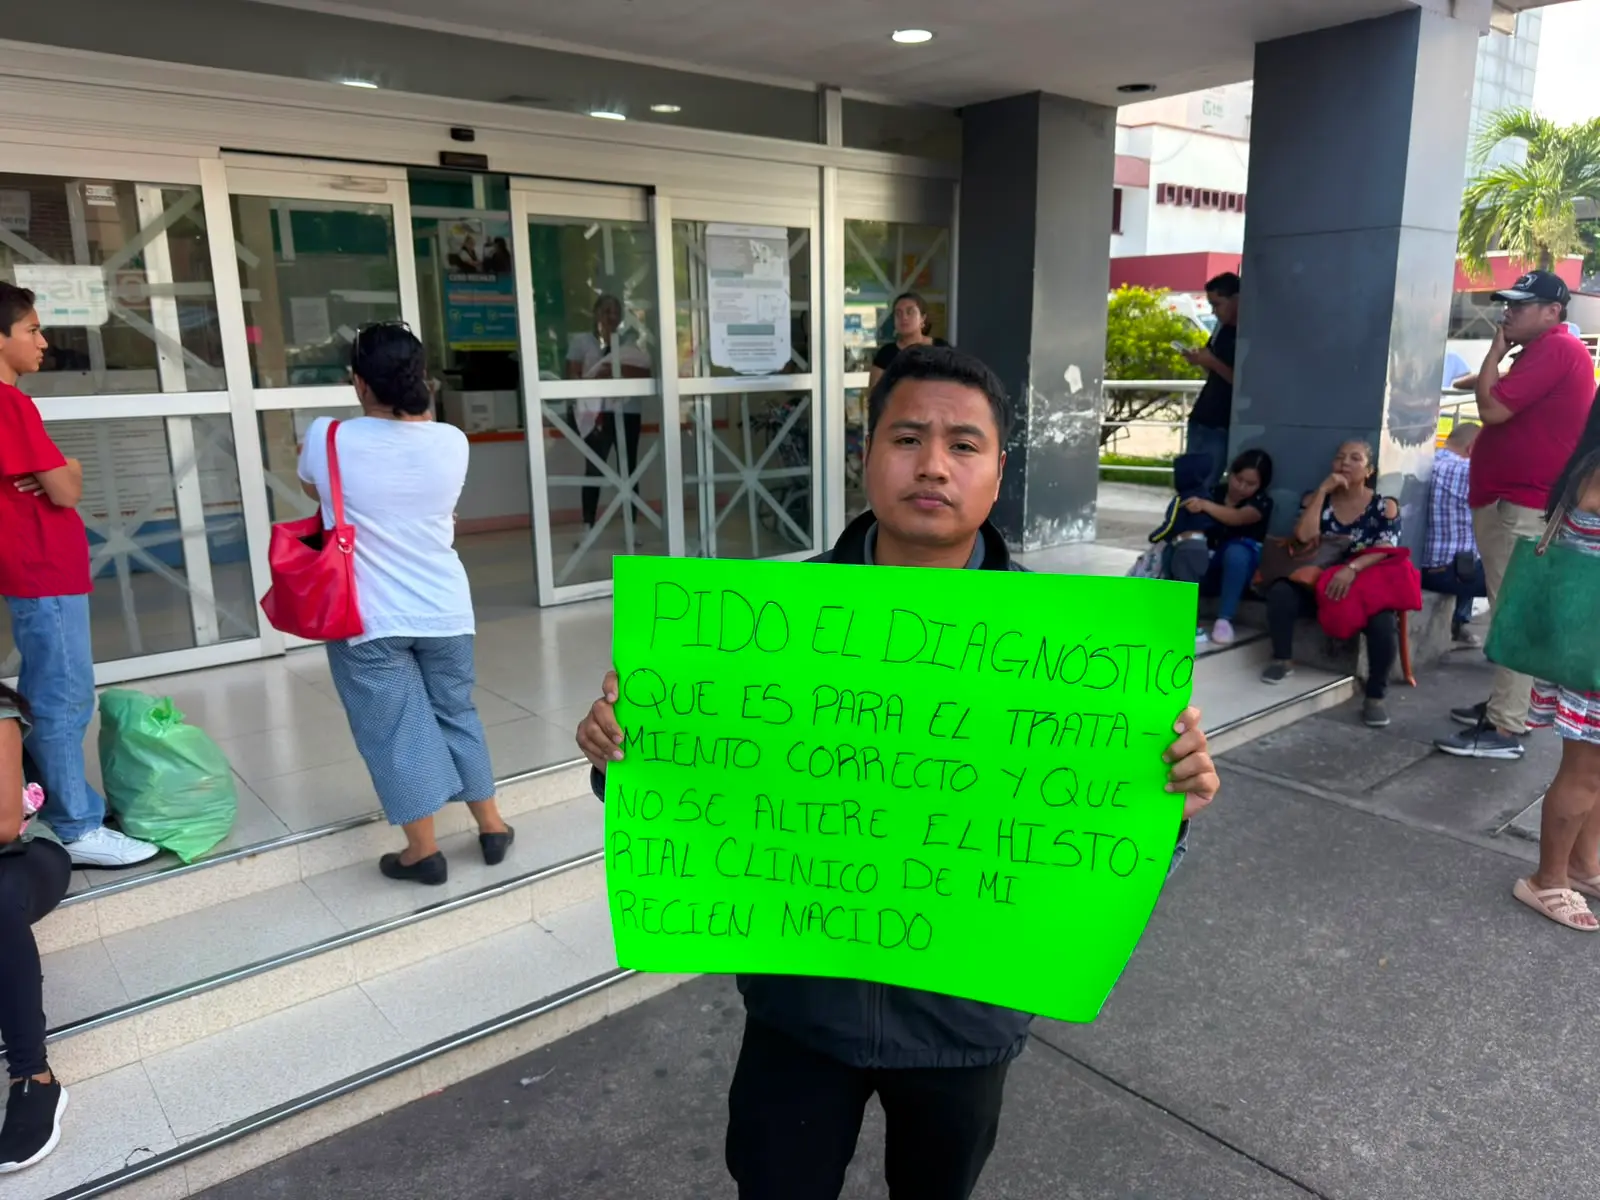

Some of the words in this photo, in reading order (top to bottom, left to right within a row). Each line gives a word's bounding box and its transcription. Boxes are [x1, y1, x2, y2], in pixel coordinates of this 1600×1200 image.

[650, 581, 789, 652] PIDO
[812, 606, 861, 660] EL
[881, 609, 1194, 696] DIAGNÓSTICO
[623, 668, 720, 718] QUE
[742, 684, 793, 726] ES
[812, 685, 904, 734] PARA
[929, 702, 971, 740] EL
[621, 726, 760, 769] MIENTO
[787, 740, 978, 793] CORRECTO
[1001, 766, 1027, 798] Y
[1040, 767, 1129, 808] QUE
[616, 785, 664, 822] NO
[672, 788, 727, 826] SE
[755, 794, 888, 839] ALTERE
[922, 814, 982, 852] EL
[612, 830, 697, 878] RIAL
[716, 837, 878, 894] CLINICO
[903, 858, 953, 897] DE
[978, 872, 1017, 905] MI
[615, 889, 754, 938] RECIEN
[782, 902, 933, 951] NACIDO
